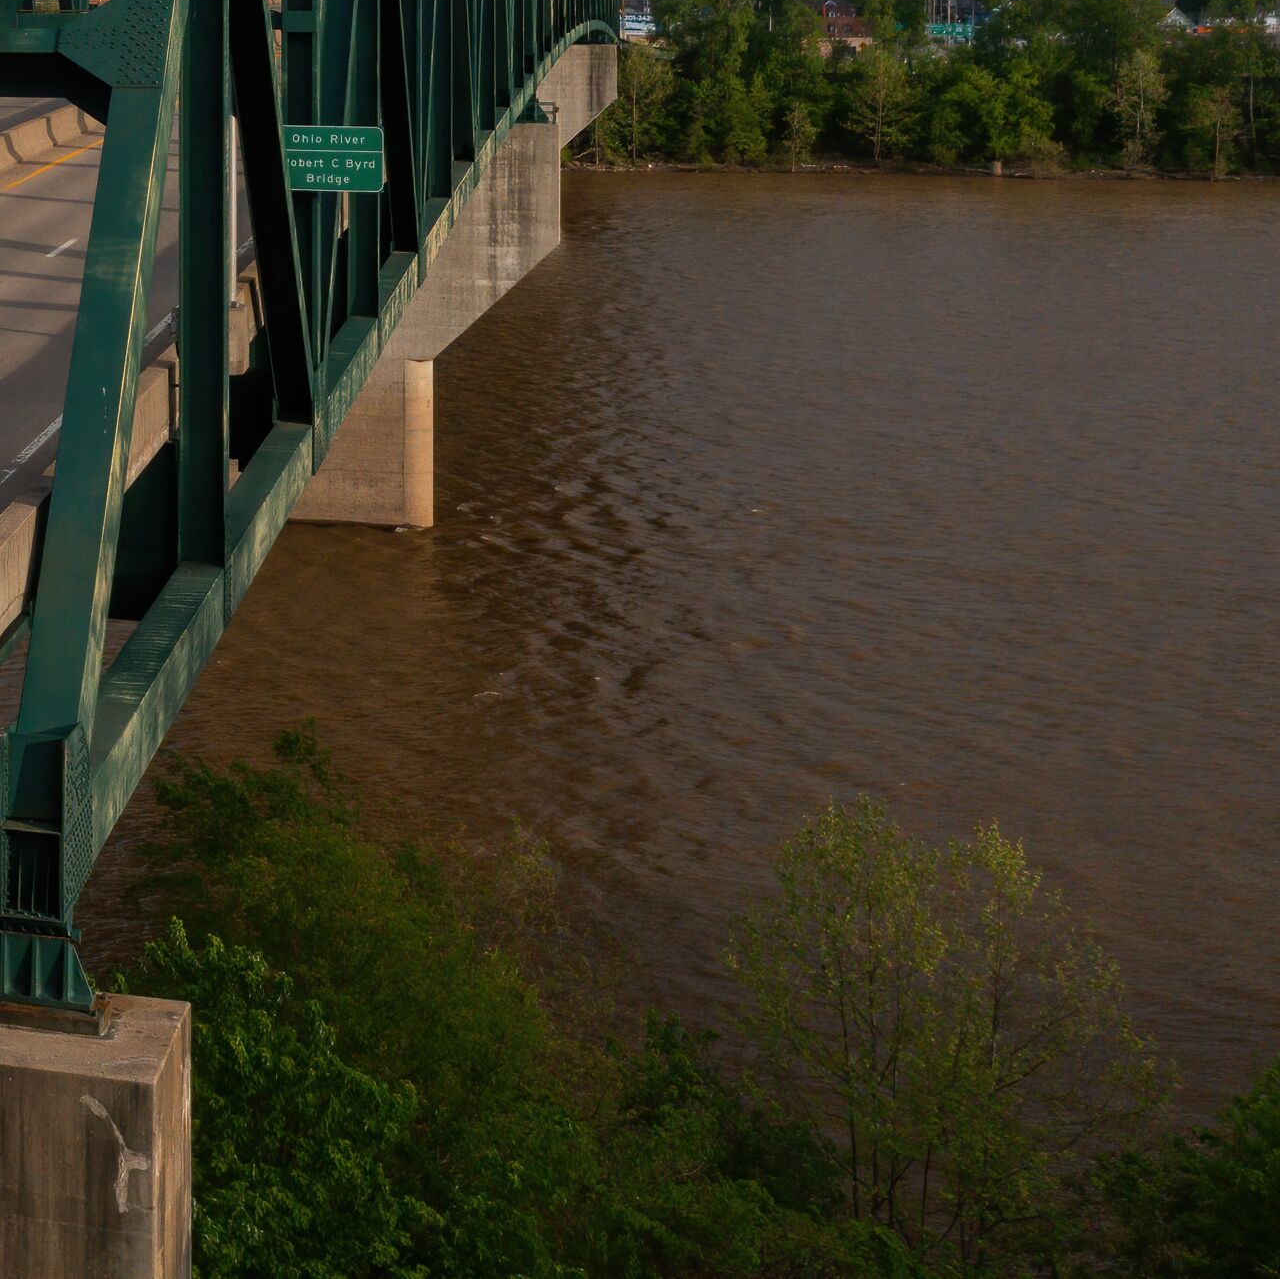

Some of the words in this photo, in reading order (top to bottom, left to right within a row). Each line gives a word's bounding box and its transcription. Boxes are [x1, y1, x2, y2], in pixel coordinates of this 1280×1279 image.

[292, 133, 322, 144] Ohio
[330, 134, 366, 144] River
[287, 158, 324, 168] obert
[331, 158, 340, 168] C
[346, 159, 375, 171] Byrd
[306, 173, 350, 186] Bridge
